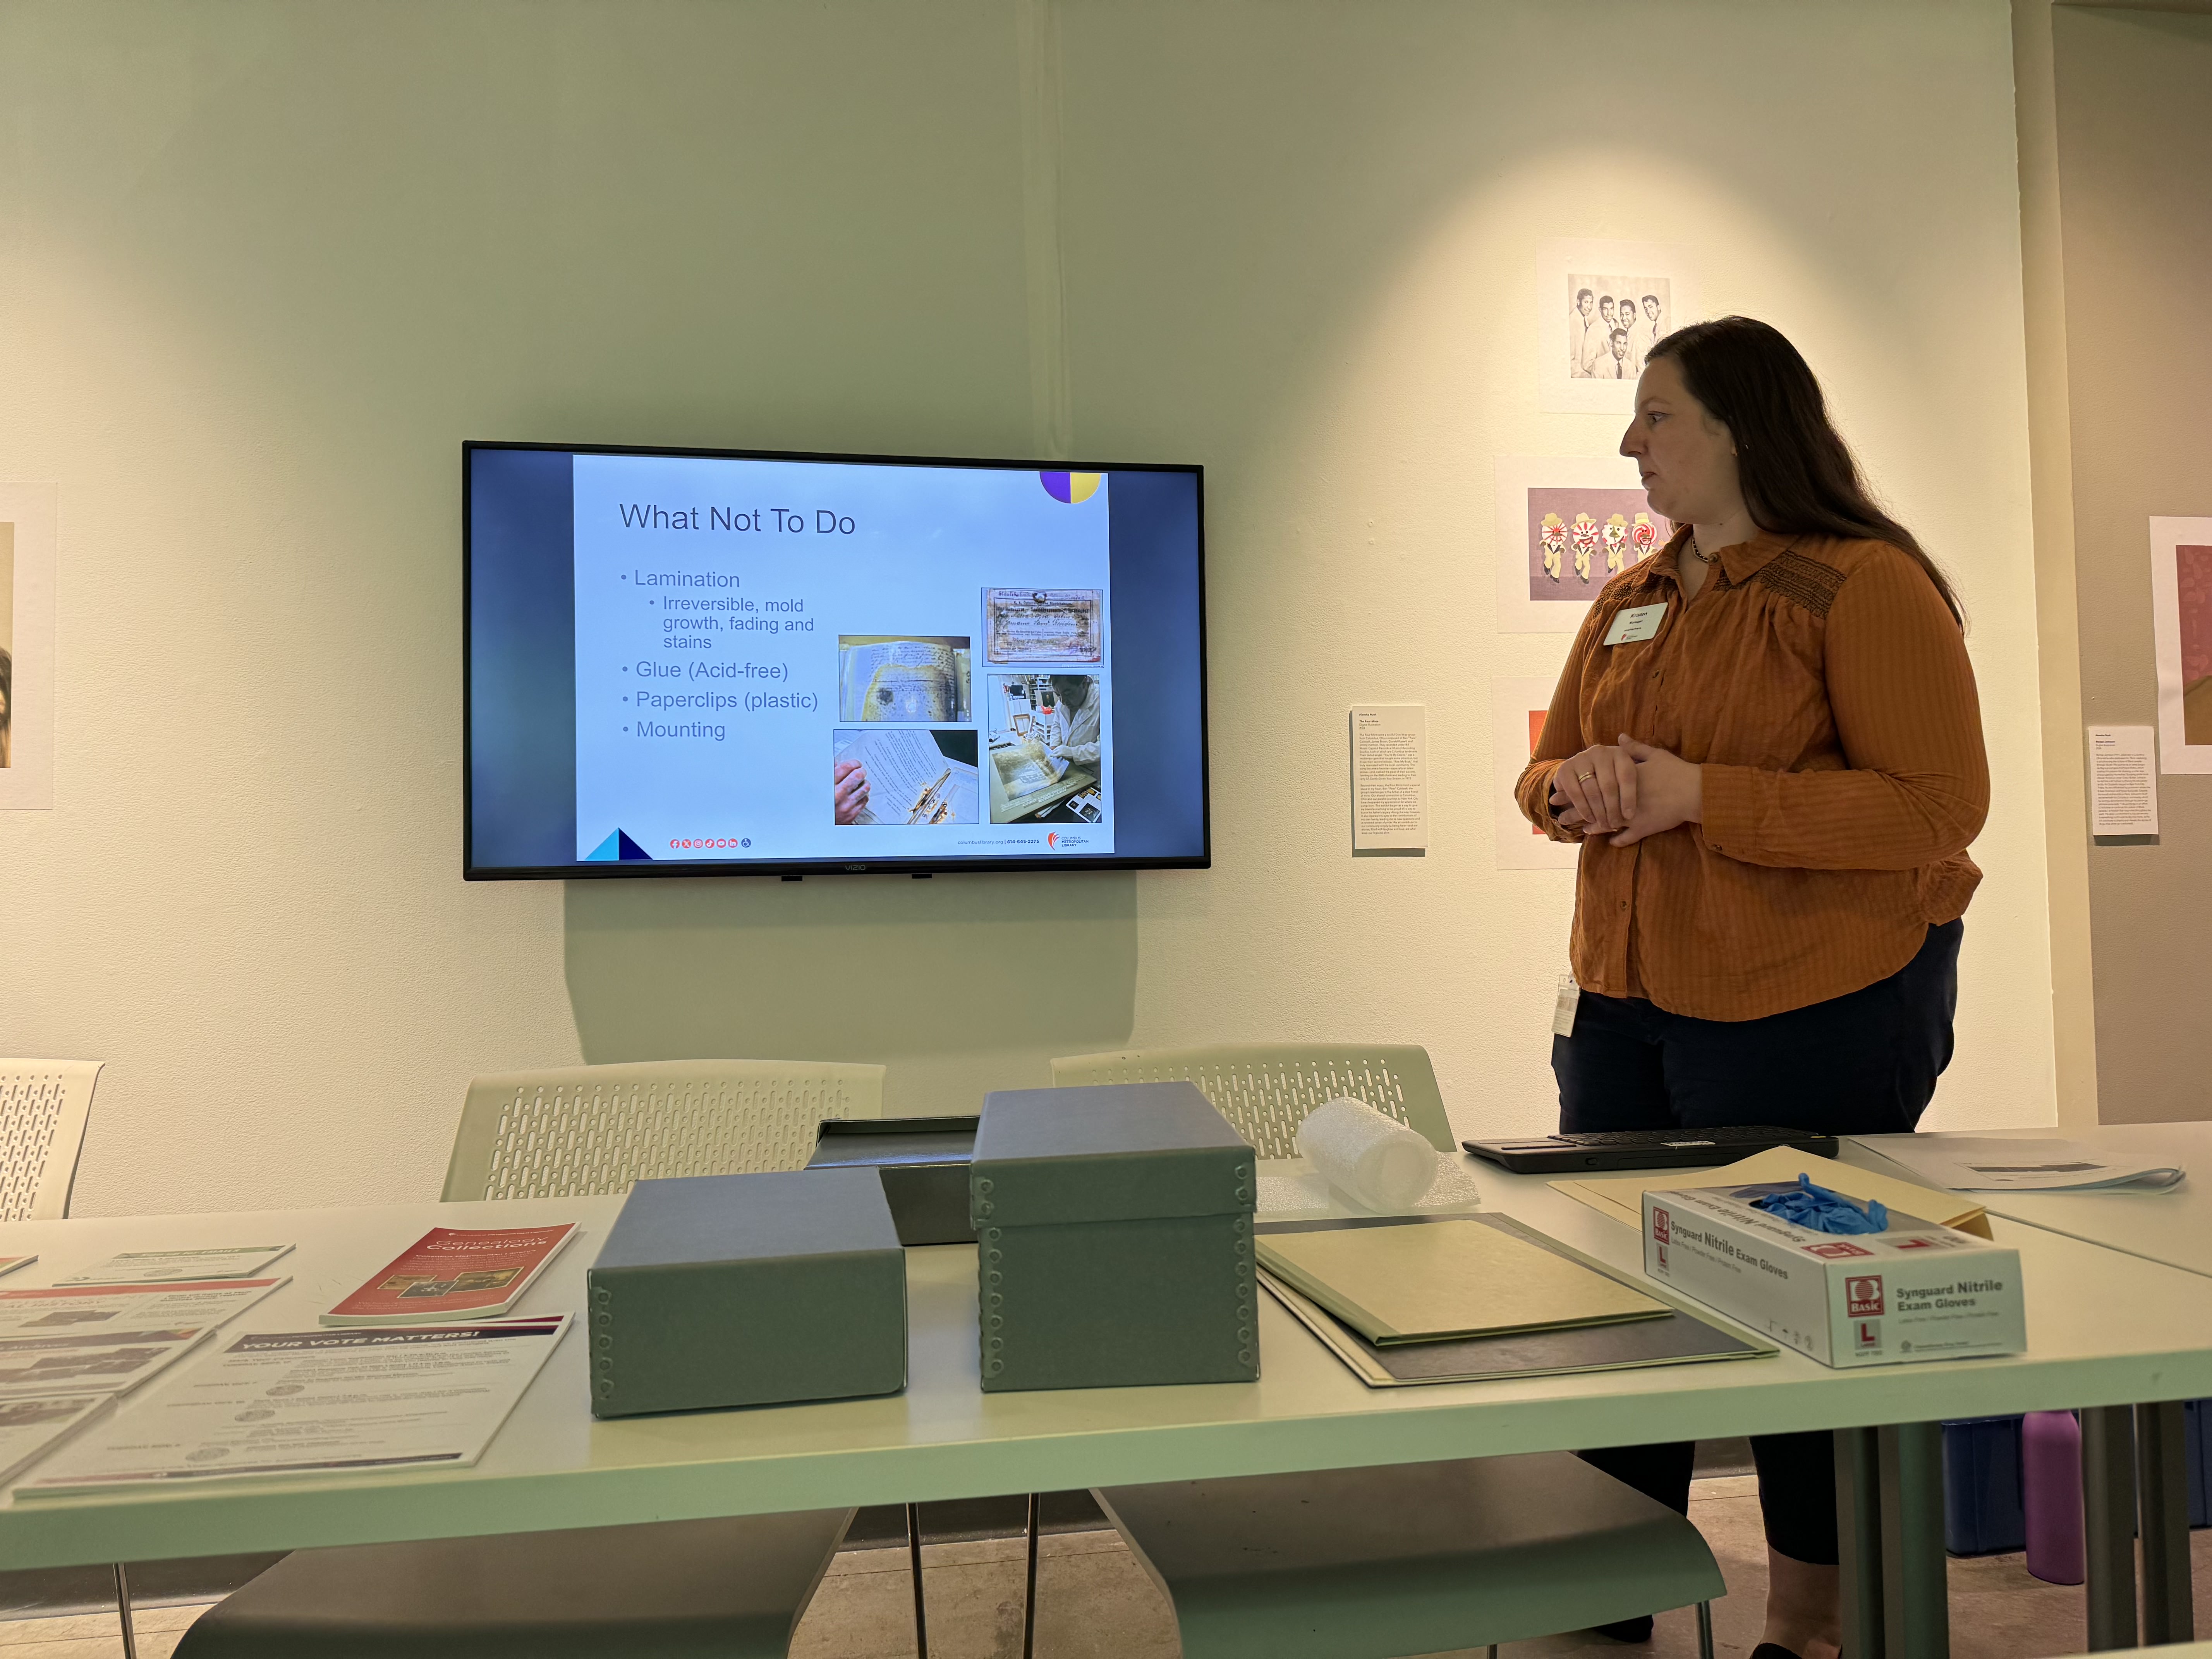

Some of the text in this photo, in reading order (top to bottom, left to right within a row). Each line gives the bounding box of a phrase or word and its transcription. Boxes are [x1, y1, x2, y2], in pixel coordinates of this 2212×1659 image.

[620, 503, 855, 534] What Not To Do
[635, 570, 740, 588] Lamination
[664, 596, 803, 613] Irreversible, mold
[663, 617, 814, 634] growth, fading and
[663, 635, 711, 649] stains
[636, 661, 788, 682] Glue (Acid-free)
[637, 691, 818, 712] Paperclips (plastic)
[637, 722, 725, 740] Mounting
[1694, 1200, 1721, 1209] Exam
[1717, 1209, 1759, 1224] Nitrile
[427, 1240, 547, 1250] Collections
[436, 1237, 548, 1245] Genealogy
[1659, 1246, 1666, 1263] L
[1671, 1221, 1788, 1279] Synguard Nitrile Exam Gloves
[1897, 1280, 2002, 1299] Synguard Nitrile
[1851, 1302, 1879, 1312] BASIC
[1898, 1298, 1975, 1311] Exam Gloves
[371, 1331, 480, 1342] MATTERS!
[1861, 1323, 1875, 1341] L
